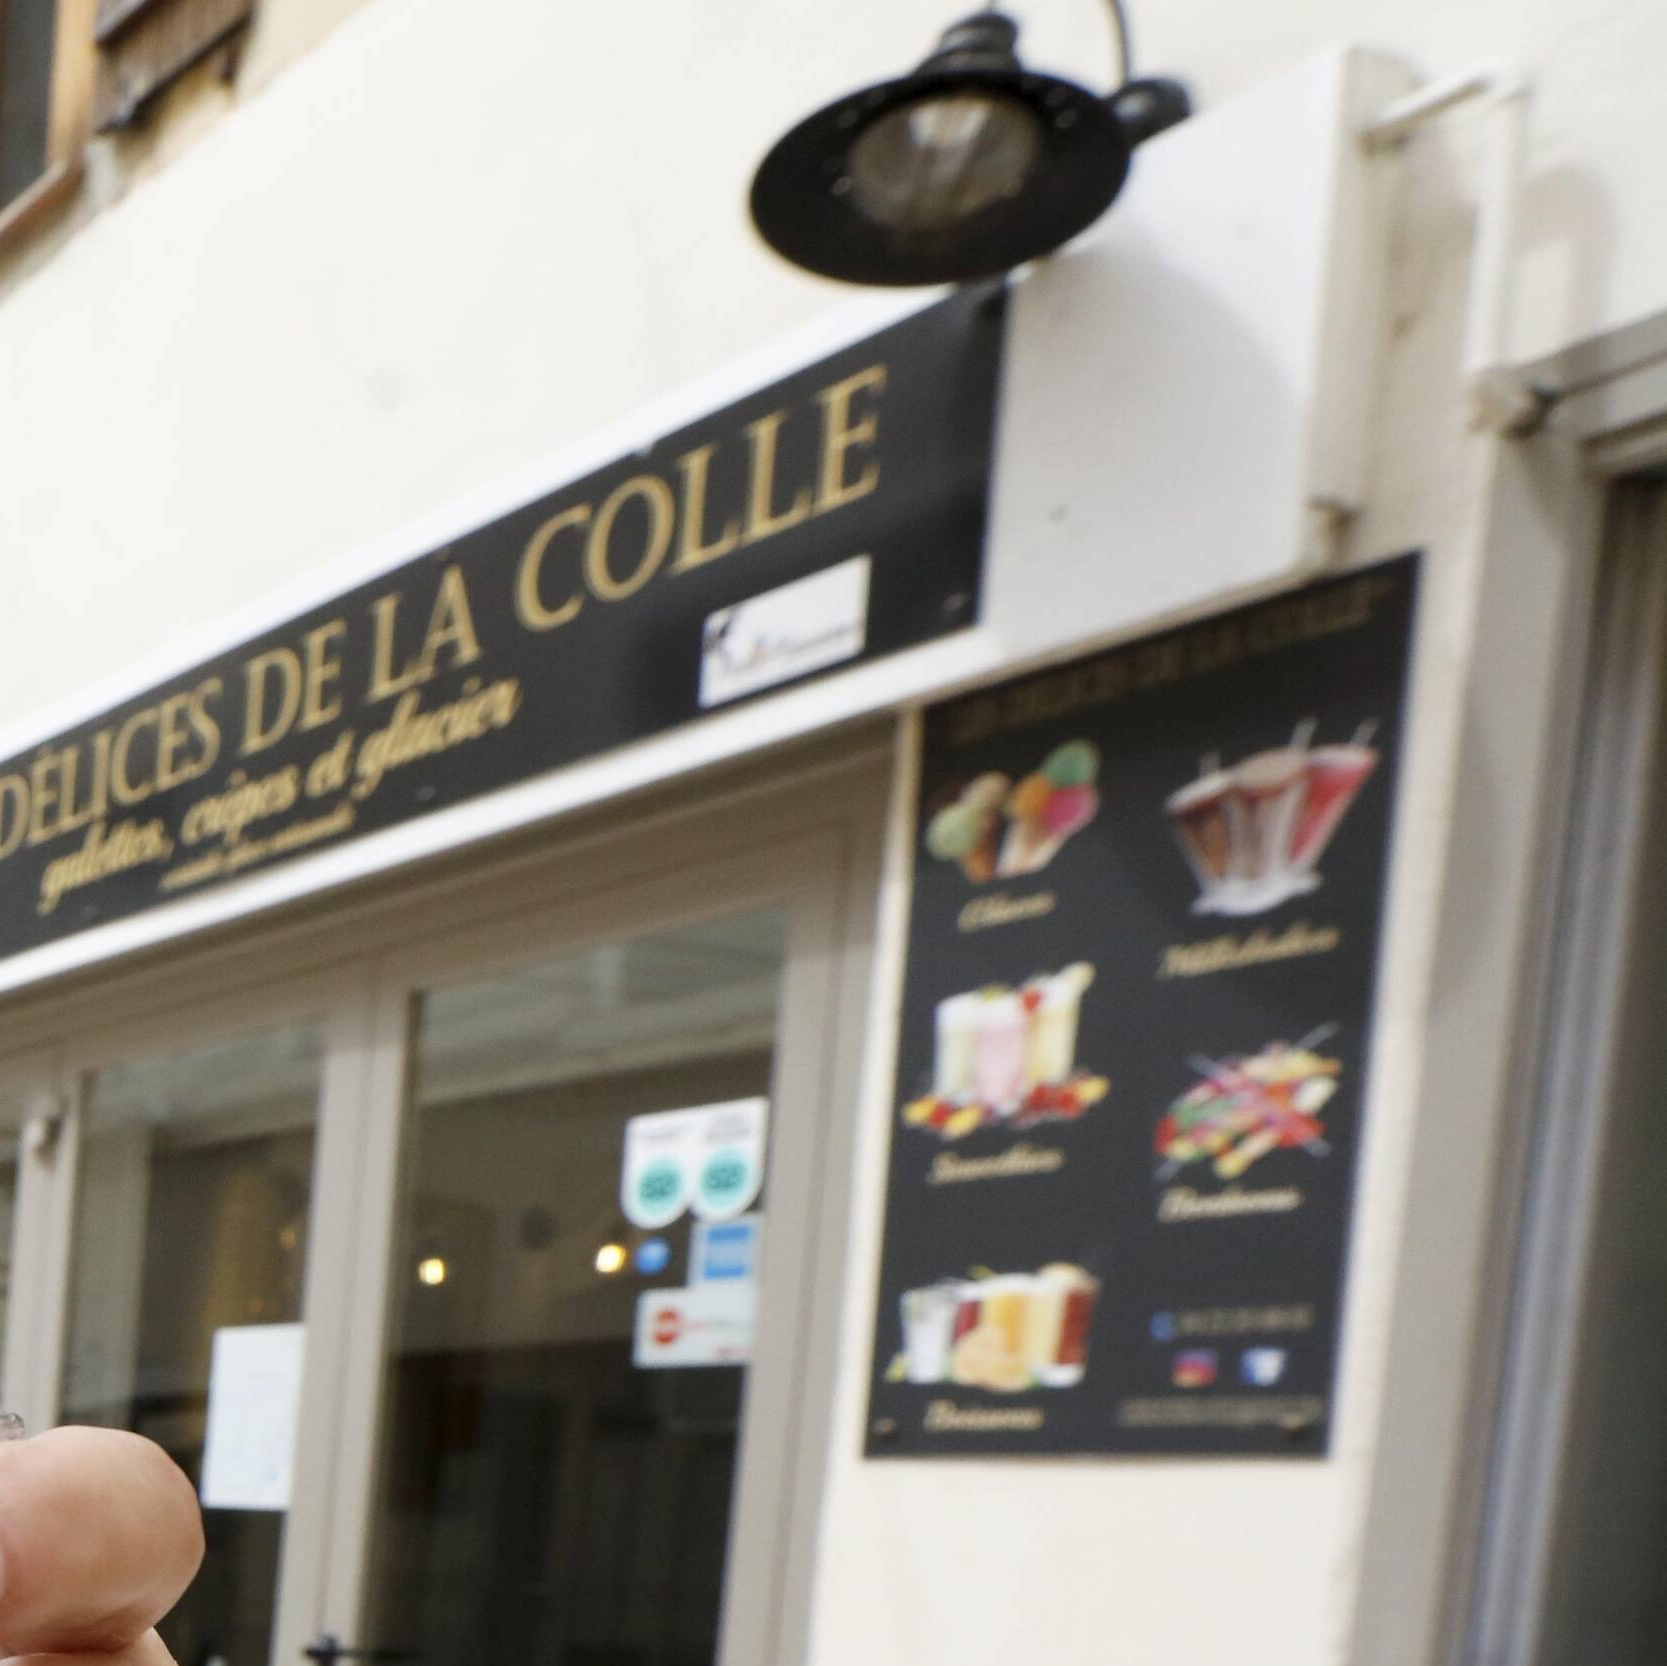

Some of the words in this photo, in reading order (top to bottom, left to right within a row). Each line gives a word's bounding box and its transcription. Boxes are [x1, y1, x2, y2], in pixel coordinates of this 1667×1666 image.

[237, 617, 348, 759] DE
[368, 563, 482, 705] LA
[513, 364, 887, 635] COLLE
